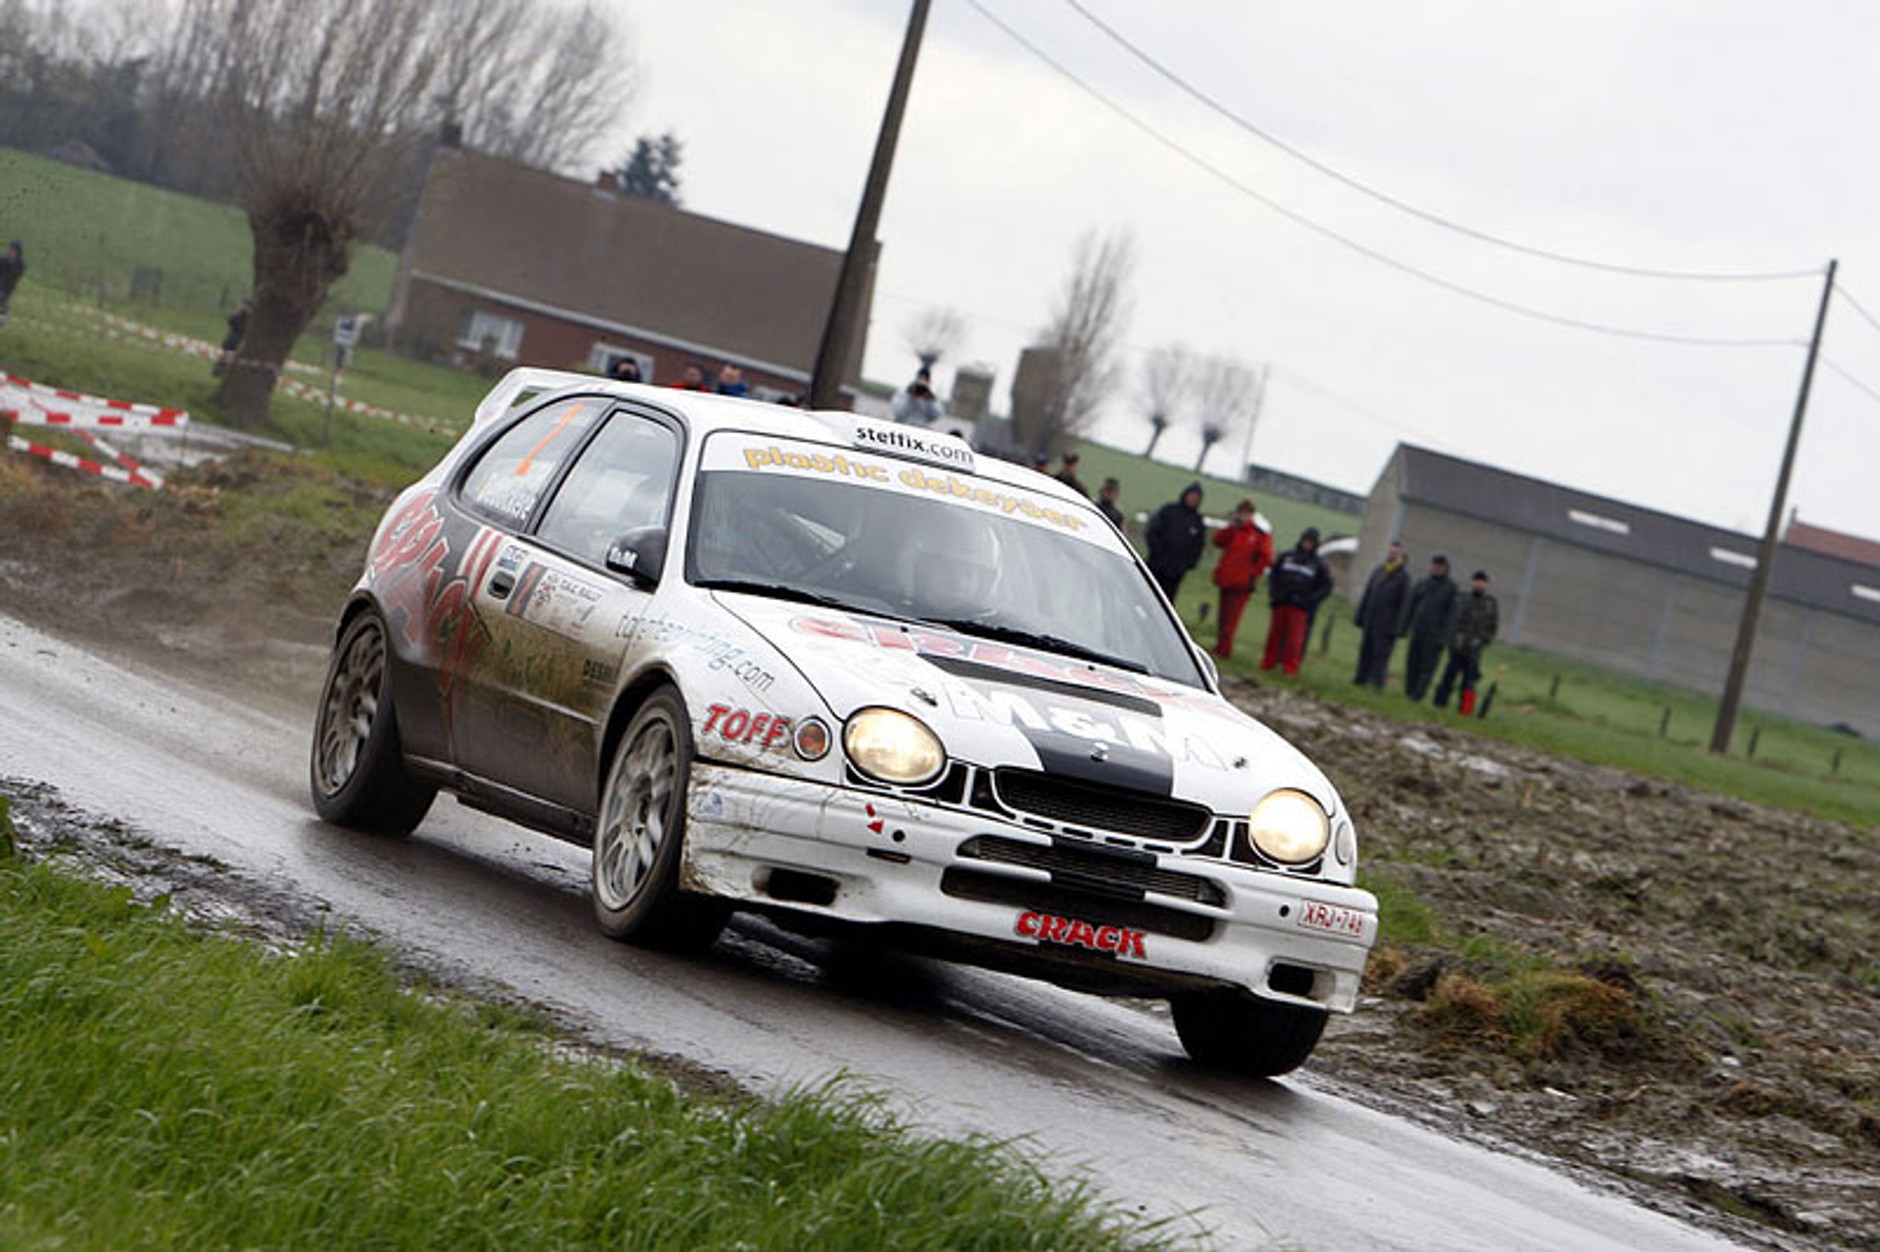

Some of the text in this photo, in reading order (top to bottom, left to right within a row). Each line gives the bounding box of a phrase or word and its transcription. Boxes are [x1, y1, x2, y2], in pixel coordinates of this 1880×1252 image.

[856, 426, 976, 466] steffix.com
[742, 446, 1088, 531] plastic dekeyser
[702, 703, 792, 749] TOFF
[944, 676, 1238, 772] M&M
[1014, 910, 1147, 959] CRACK
